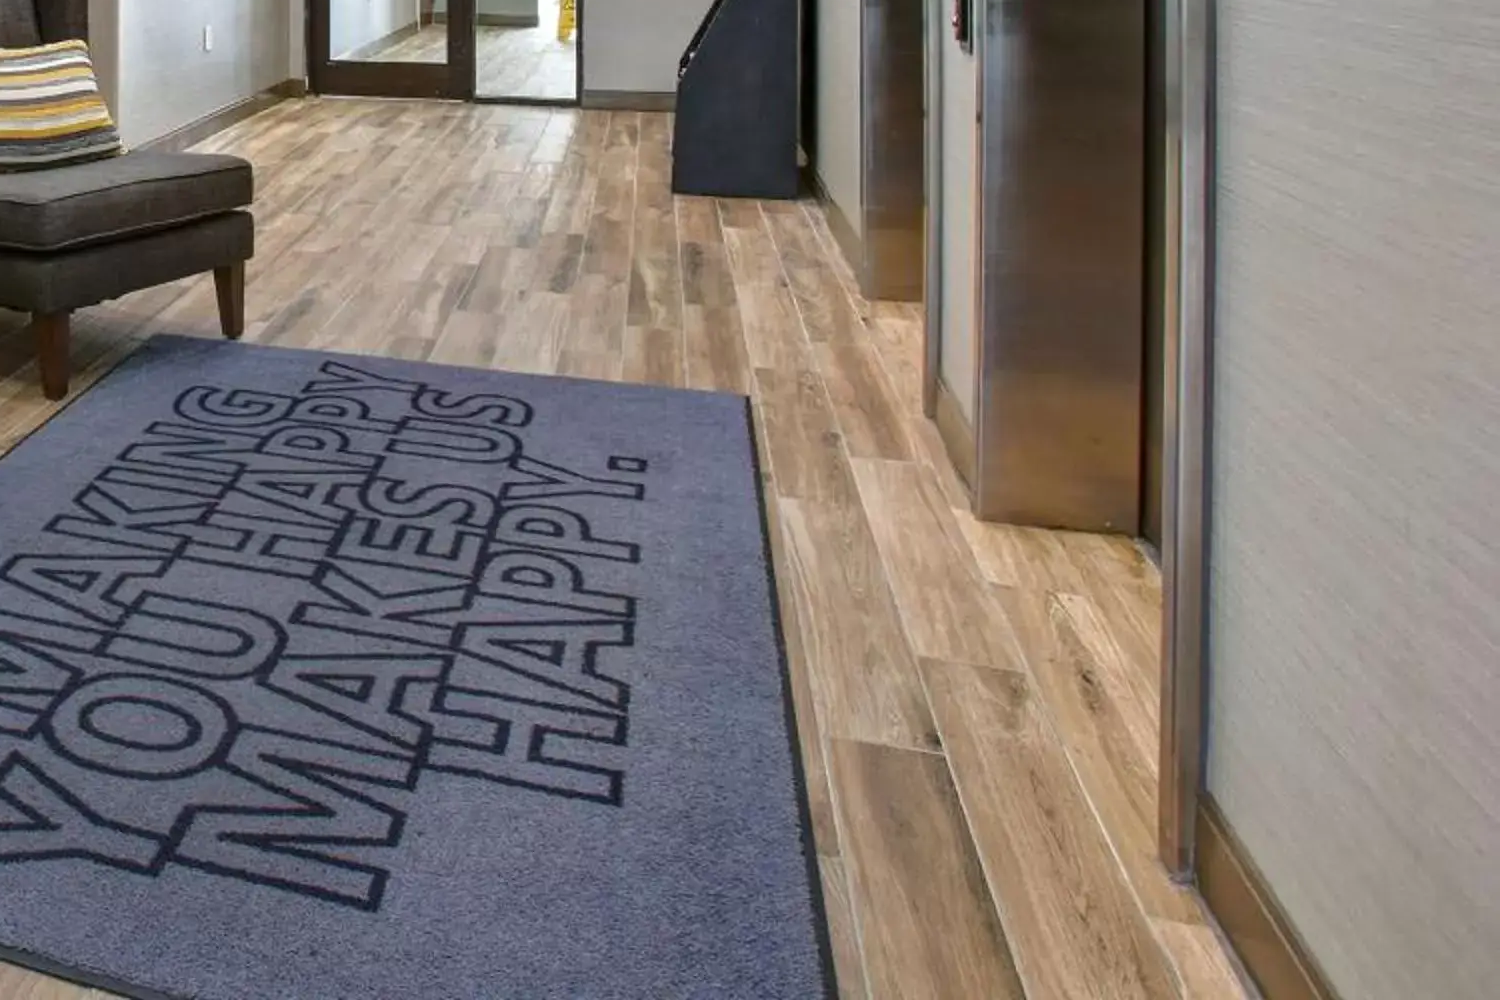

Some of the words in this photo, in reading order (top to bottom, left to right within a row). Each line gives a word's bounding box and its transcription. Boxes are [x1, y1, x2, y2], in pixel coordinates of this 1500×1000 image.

[167, 477, 498, 912] MAKES
[385, 383, 534, 465] US
[179, 361, 427, 581] HAPPY
[428, 454, 647, 807] HAPPY.
